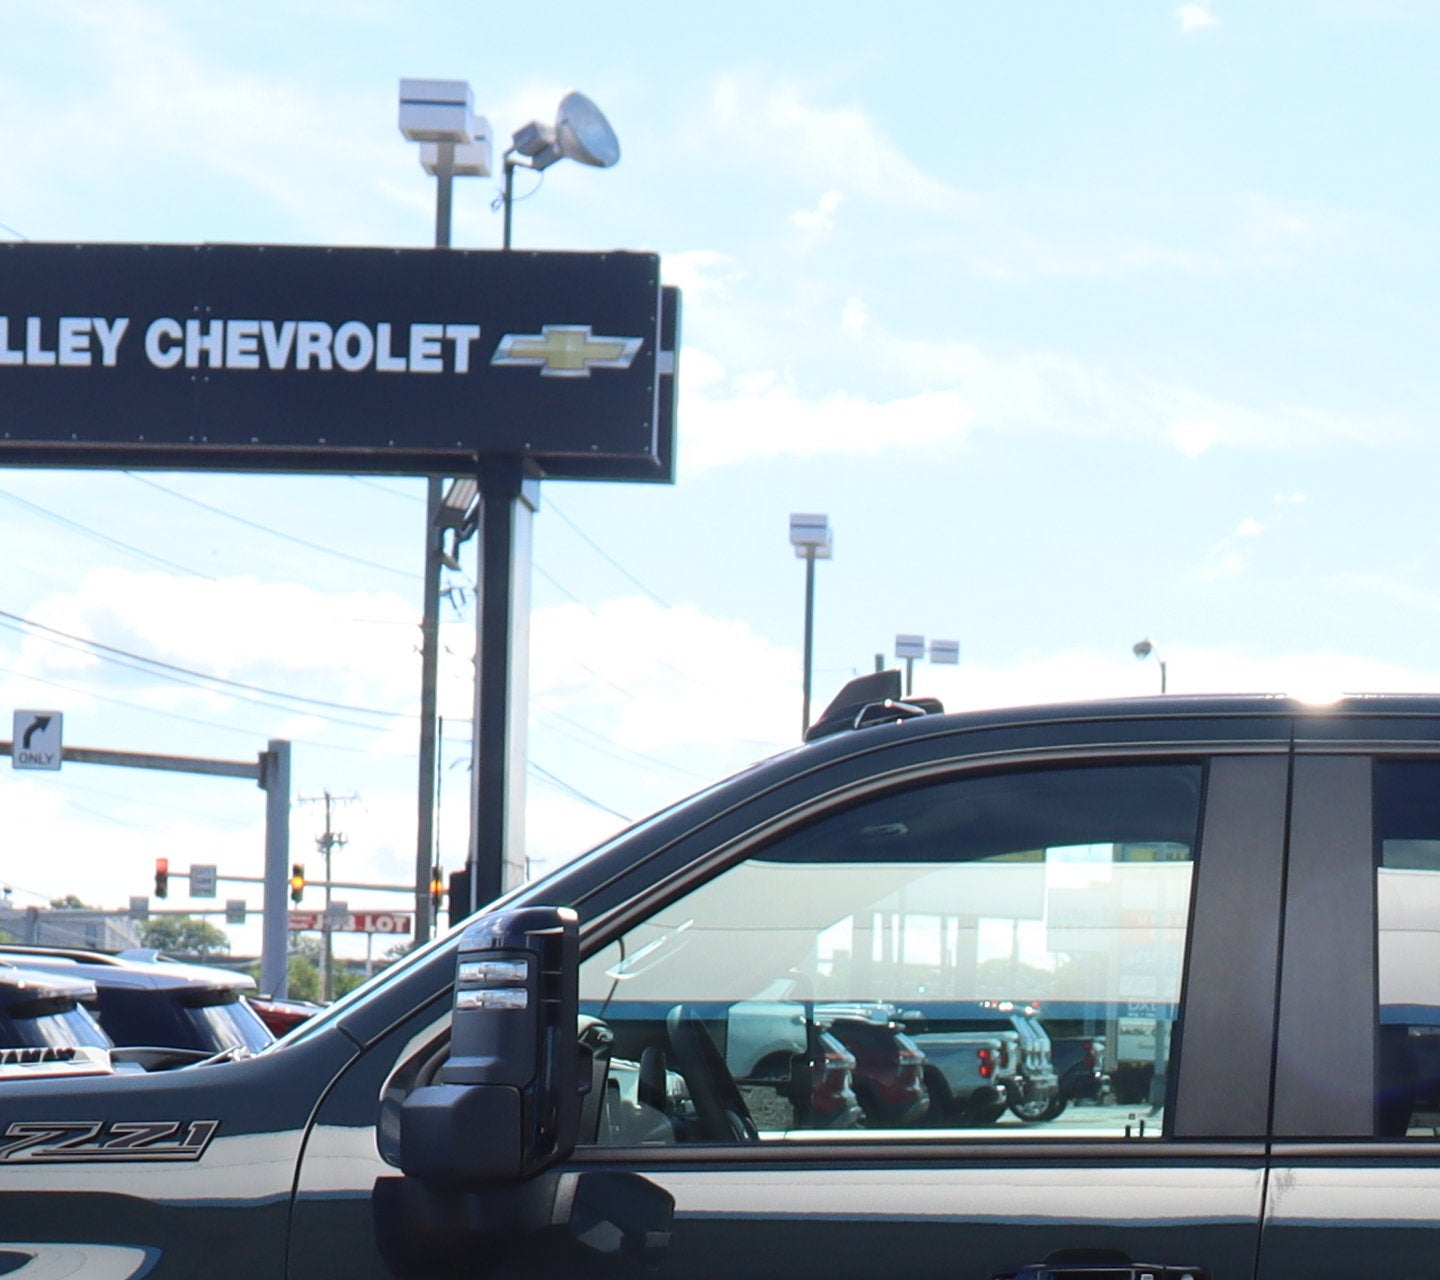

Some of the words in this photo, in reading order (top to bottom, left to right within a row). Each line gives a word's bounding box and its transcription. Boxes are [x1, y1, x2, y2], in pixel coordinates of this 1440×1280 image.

[145, 320, 481, 374] CHEVROLET
[18, 752, 54, 765] ONLY
[364, 913, 407, 933] LOT
